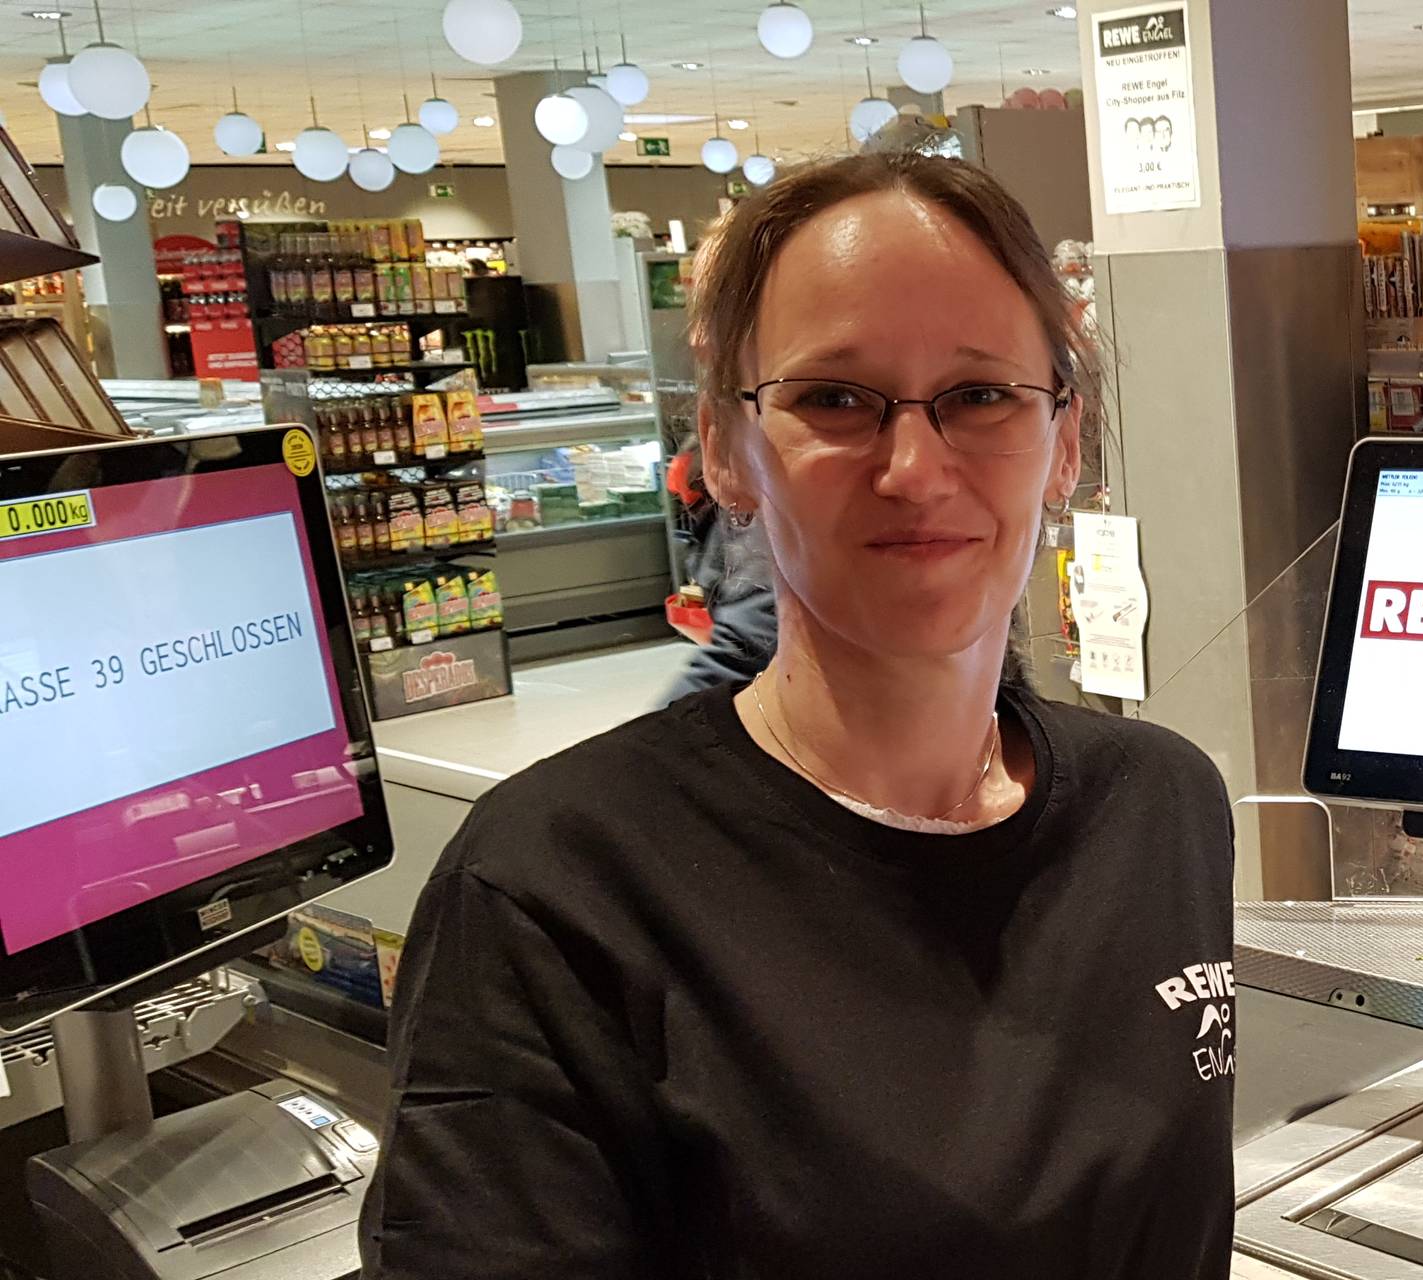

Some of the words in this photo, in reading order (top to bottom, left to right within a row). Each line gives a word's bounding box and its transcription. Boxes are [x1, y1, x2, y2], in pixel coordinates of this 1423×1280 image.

[1103, 25, 1140, 48] REWE
[1142, 27, 1173, 43] ENGEL
[1106, 59, 1120, 67] NEU
[1121, 79, 1144, 91] REWE
[1146, 78, 1168, 90] Engel
[1106, 94, 1154, 107] City-Shopper
[1157, 93, 1170, 101] aus
[1171, 90, 1185, 99] Filz
[198, 190, 327, 219] versüßen
[7, 500, 70, 532] 0.000
[70, 501, 89, 522] kg
[0, 666, 75, 714] ASSE
[91, 655, 125, 689] 39
[139, 611, 304, 676] GESCHLOSSEN
[1155, 961, 1235, 1011] REWE
